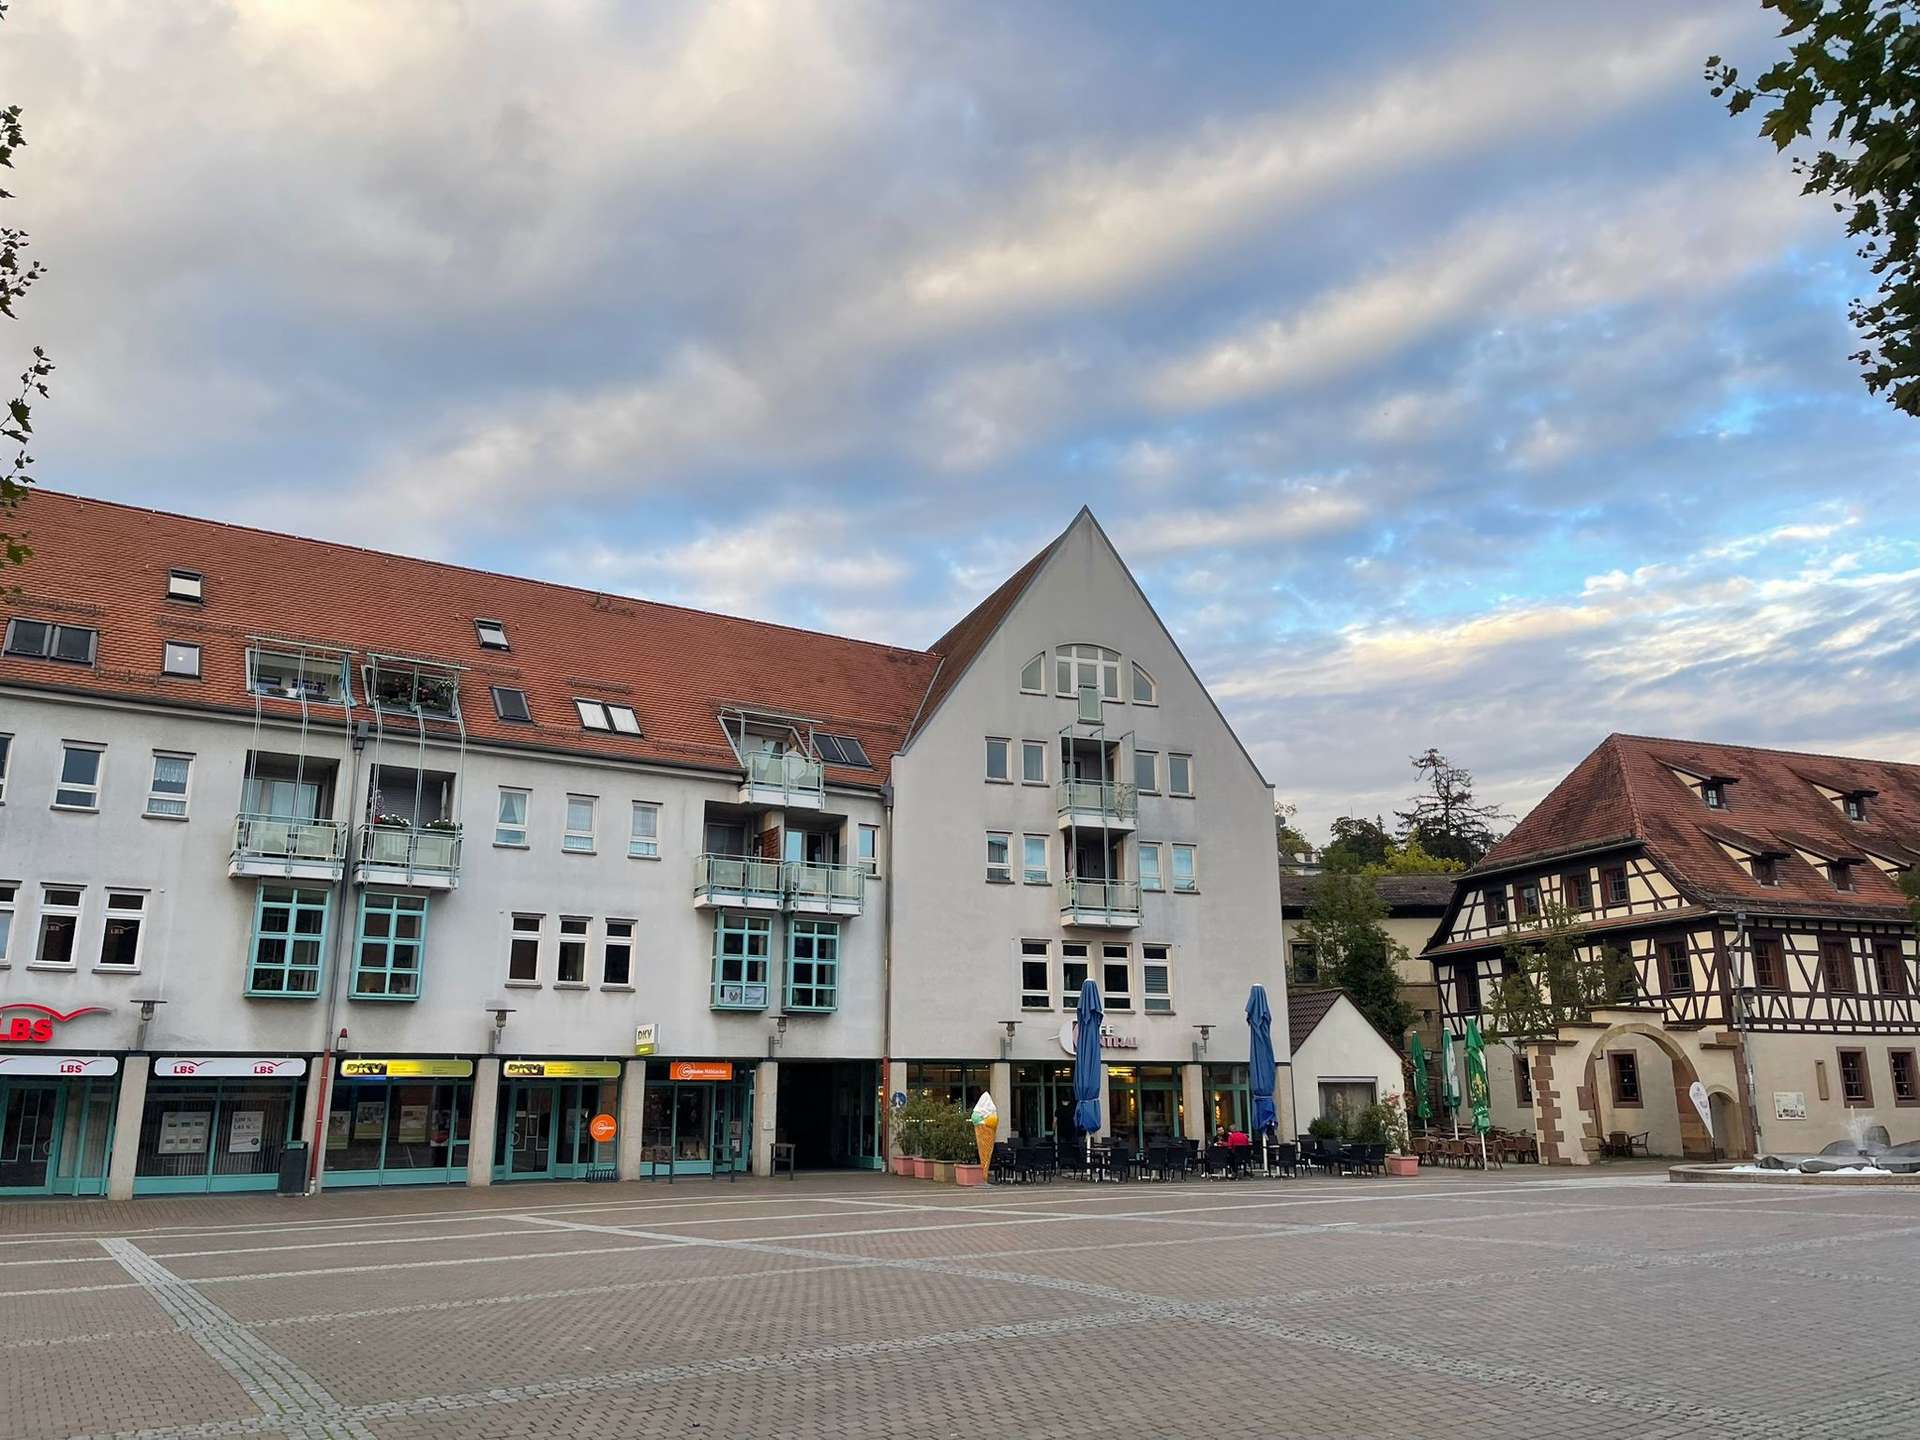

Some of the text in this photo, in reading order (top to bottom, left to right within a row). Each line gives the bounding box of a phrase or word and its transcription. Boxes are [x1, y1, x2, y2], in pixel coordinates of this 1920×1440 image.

[638, 1029, 653, 1040] DKV
[60, 1064, 83, 1073] LBS
[173, 1065, 195, 1074] LBS
[254, 1065, 274, 1074] LBS
